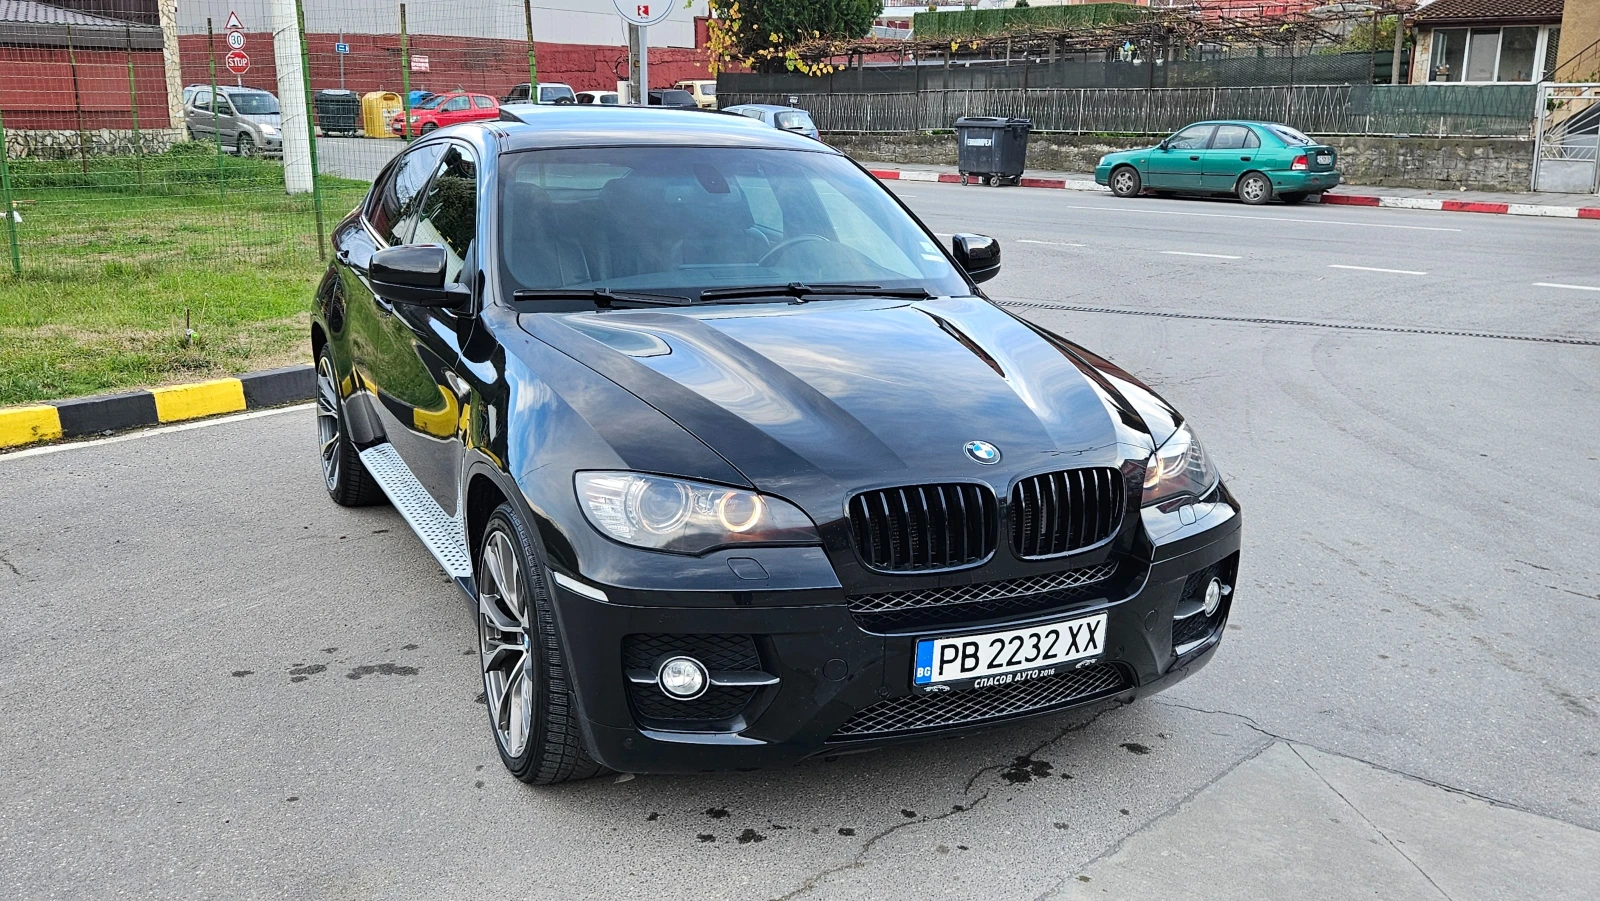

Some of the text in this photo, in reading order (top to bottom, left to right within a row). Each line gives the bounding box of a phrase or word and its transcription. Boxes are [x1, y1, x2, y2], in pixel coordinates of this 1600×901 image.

[231, 35, 241, 45] 30
[228, 58, 247, 67] STOP
[938, 619, 1102, 676] PB 2232 XX
[916, 667, 932, 678] BG
[974, 668, 1056, 689] СПАСОВ АУТО 2016
